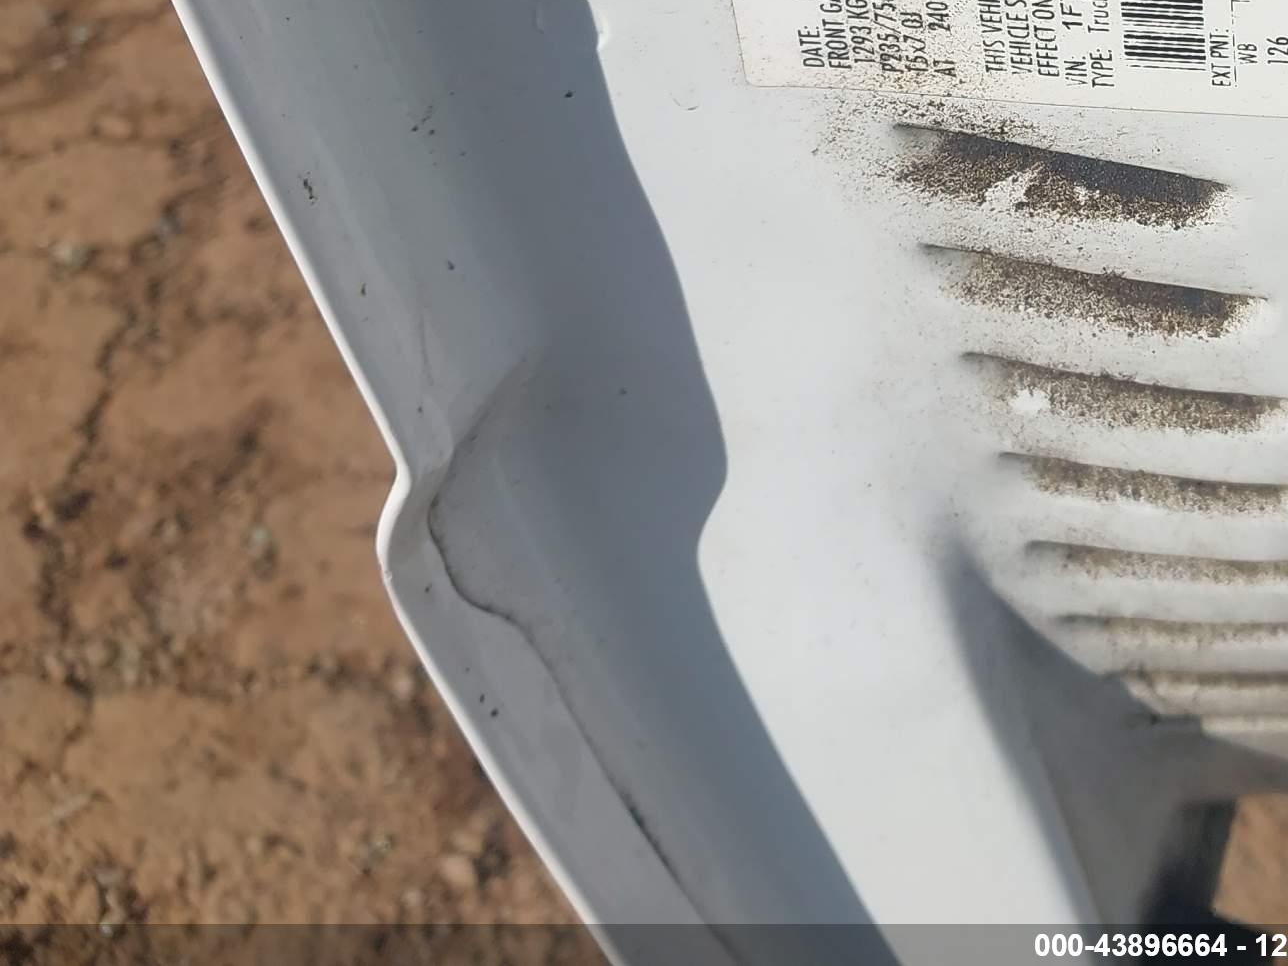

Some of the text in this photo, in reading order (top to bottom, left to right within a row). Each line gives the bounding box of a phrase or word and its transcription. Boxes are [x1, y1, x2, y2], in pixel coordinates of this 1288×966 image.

[924, 0, 951, 31] 240
[796, 24, 825, 68] DATE:
[820, 18, 852, 69] FRONT
[848, 24, 877, 64] 1293
[982, 39, 1007, 73] THIS
[1005, 12, 1034, 75] VEHICLE
[1032, 25, 1061, 77] EFFECT
[1208, 27, 1230, 58] PNT:
[1238, 42, 1257, 64] WB
[931, 58, 956, 77] AT
[1063, 54, 1088, 87] VIN:
[1088, 48, 1115, 88] TYPE:
[1210, 62, 1231, 86] EXT
